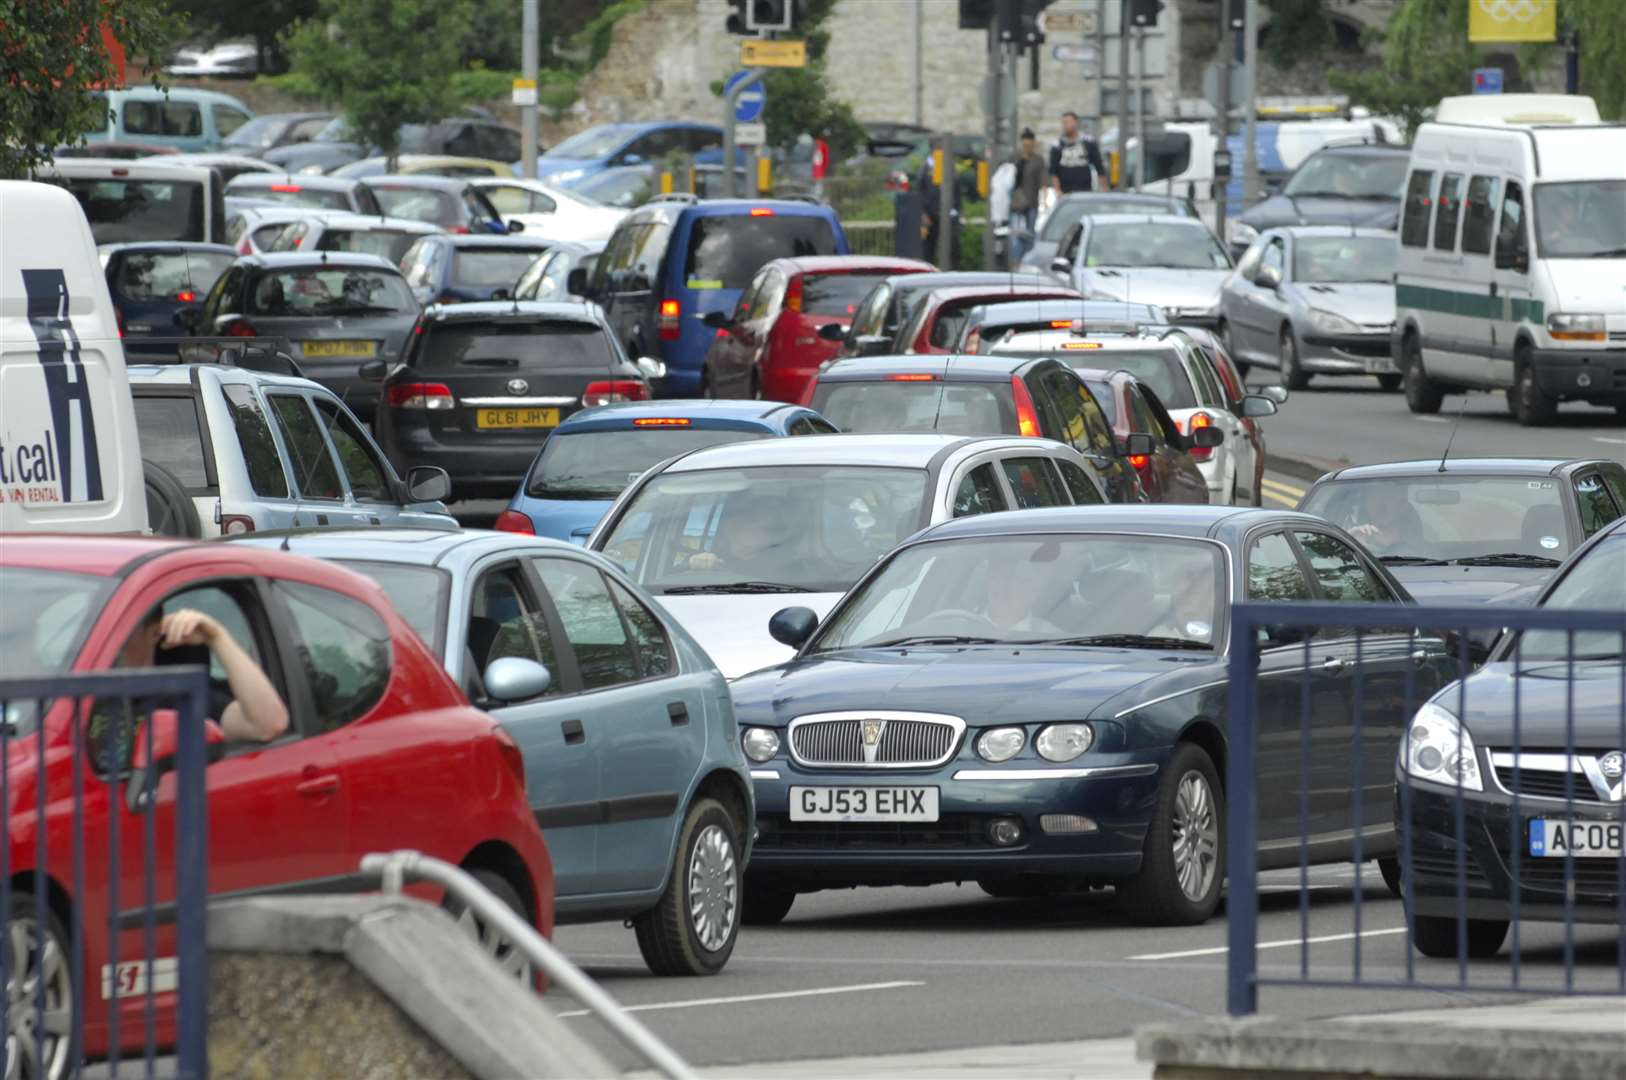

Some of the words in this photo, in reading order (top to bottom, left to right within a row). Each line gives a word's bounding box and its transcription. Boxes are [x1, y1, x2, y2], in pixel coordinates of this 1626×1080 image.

[487, 411, 518, 425] GL61
[523, 410, 549, 424] JHY
[28, 487, 59, 502] RENTAL
[802, 790, 867, 814] GJ53
[875, 790, 925, 814] EHX
[1552, 824, 1621, 850] AC08
